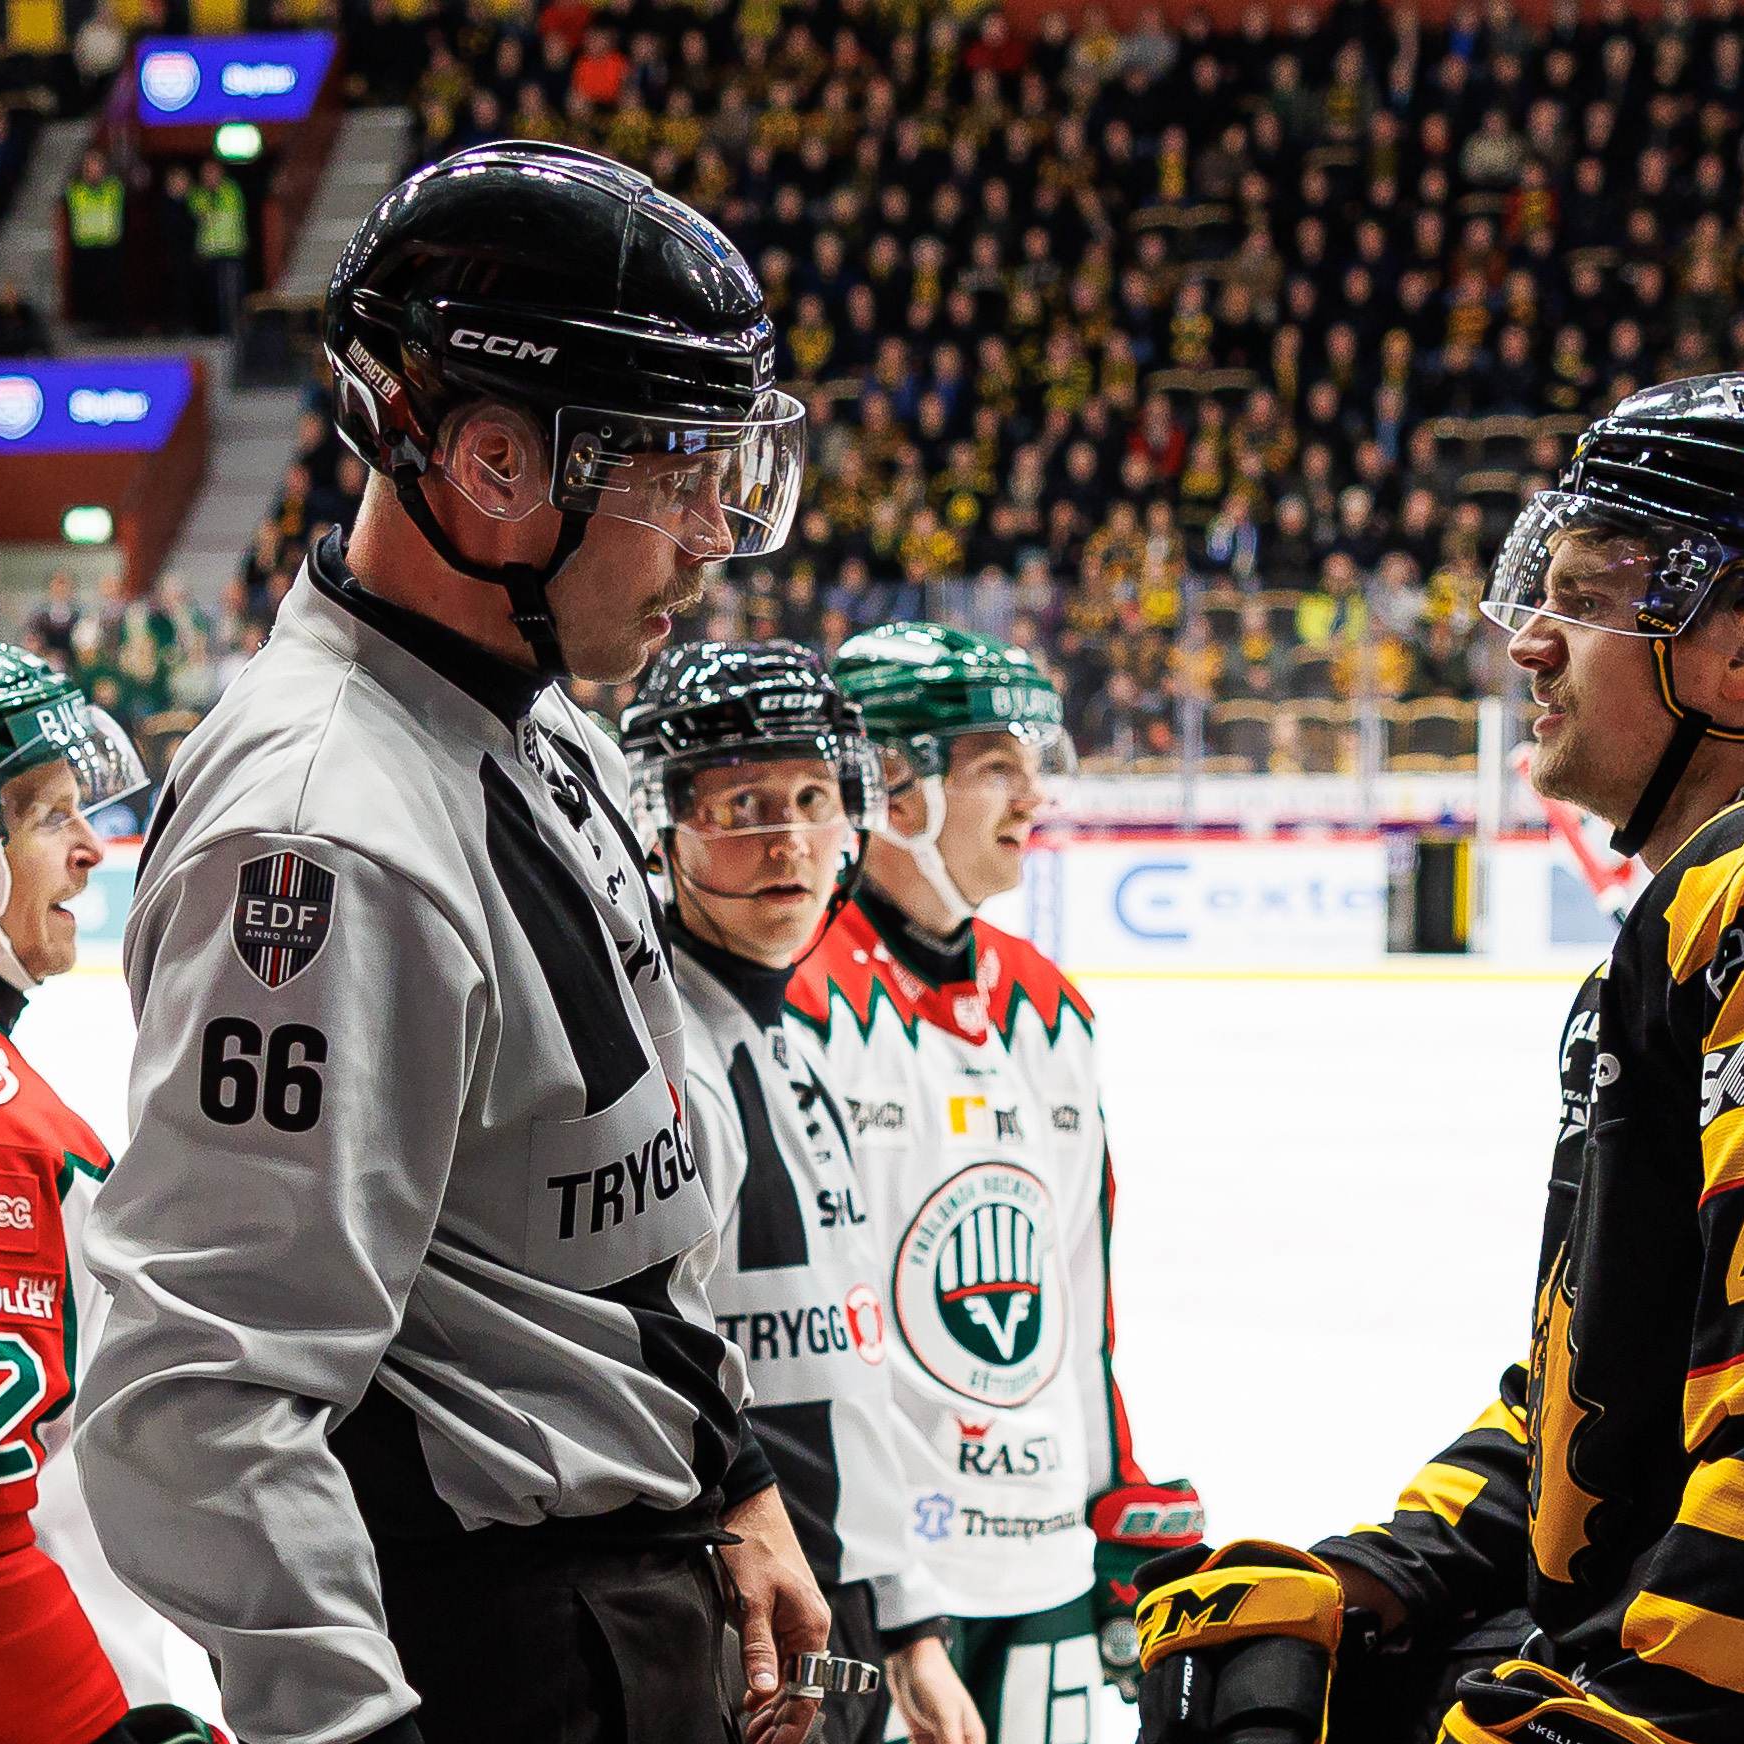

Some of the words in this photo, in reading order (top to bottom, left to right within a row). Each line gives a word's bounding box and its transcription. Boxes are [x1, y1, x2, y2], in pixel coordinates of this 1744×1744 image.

[450, 328, 559, 367] CCM
[347, 338, 388, 386] IMPACT
[381, 376, 402, 399] BY
[1637, 612, 1677, 634] CCM
[244, 899, 318, 931] EDF
[244, 928, 282, 942] ANNO
[199, 1015, 329, 1133] 66
[717, 1308, 849, 1362] TRYGG
